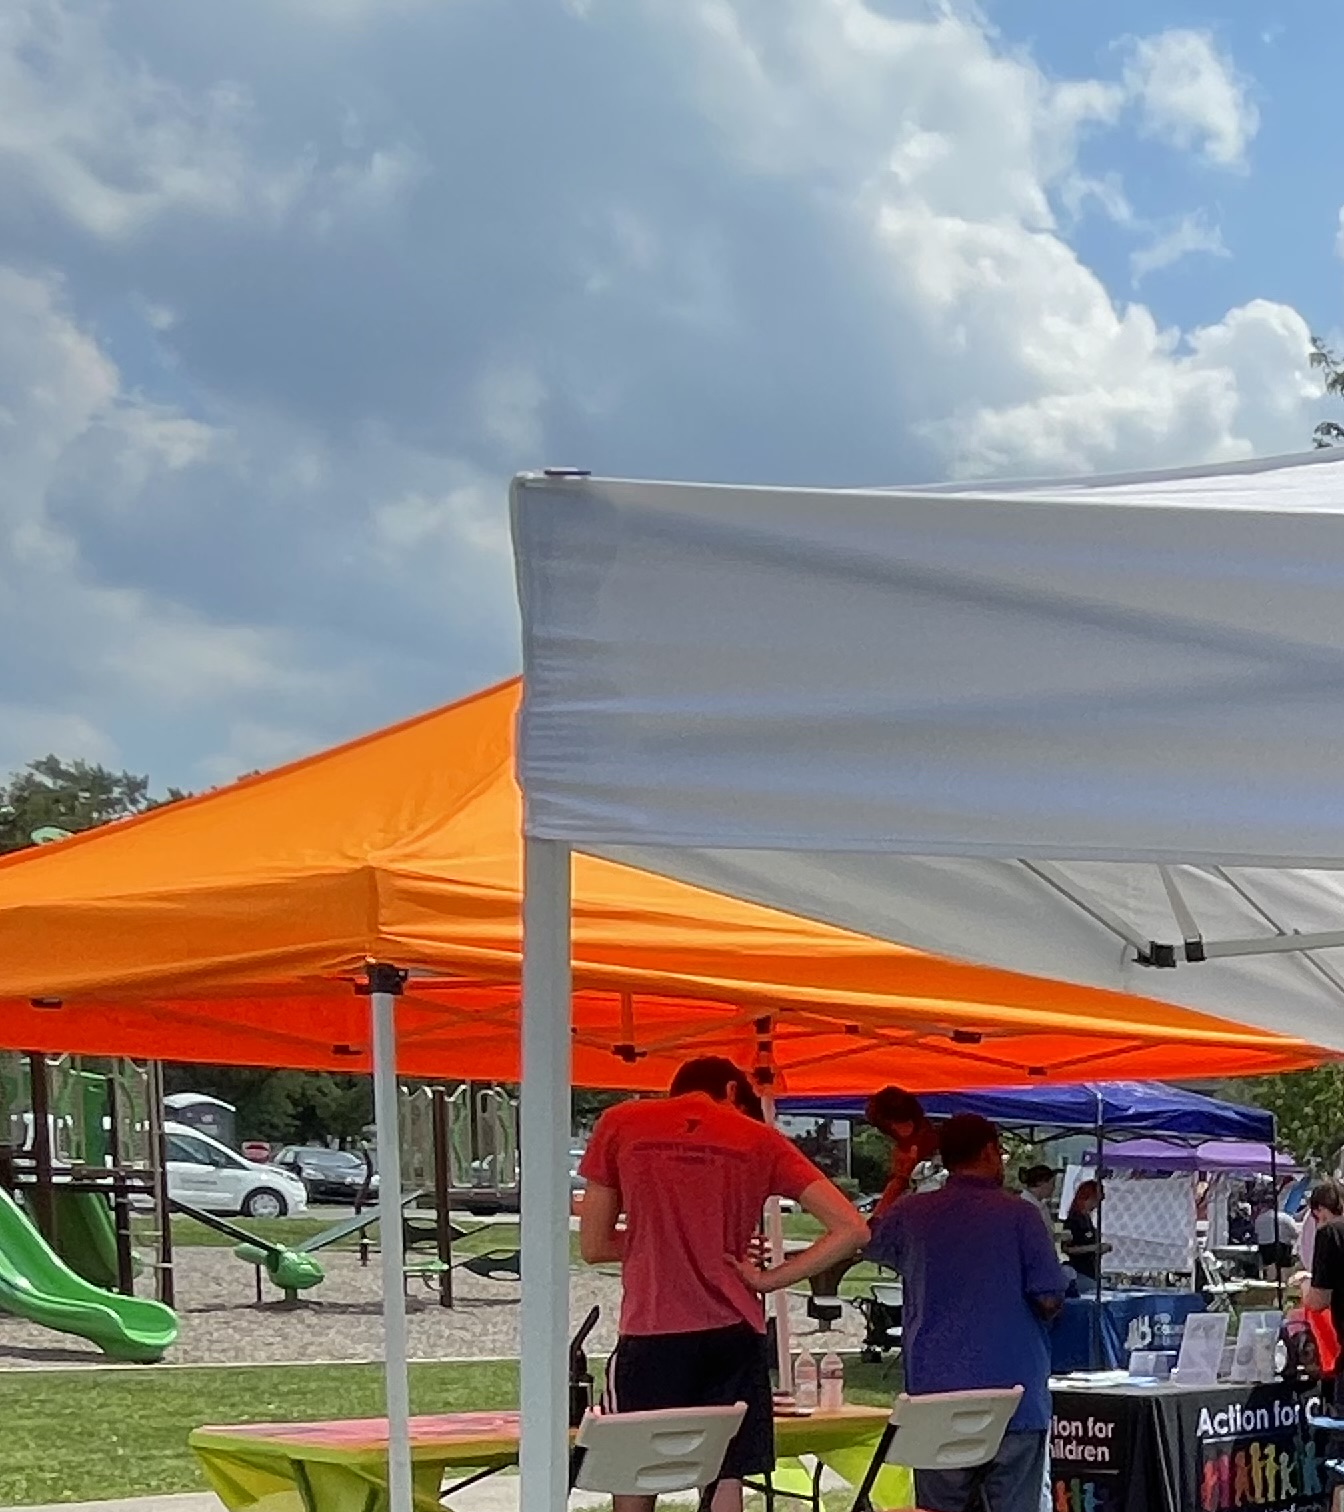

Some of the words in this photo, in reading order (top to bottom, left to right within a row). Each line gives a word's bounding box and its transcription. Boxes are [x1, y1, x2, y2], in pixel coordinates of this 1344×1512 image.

[1052, 1414, 1083, 1437] ion
[1087, 1416, 1115, 1438] for
[1196, 1402, 1269, 1437] Action
[1273, 1400, 1300, 1428] for
[1048, 1438, 1110, 1462] ildren
